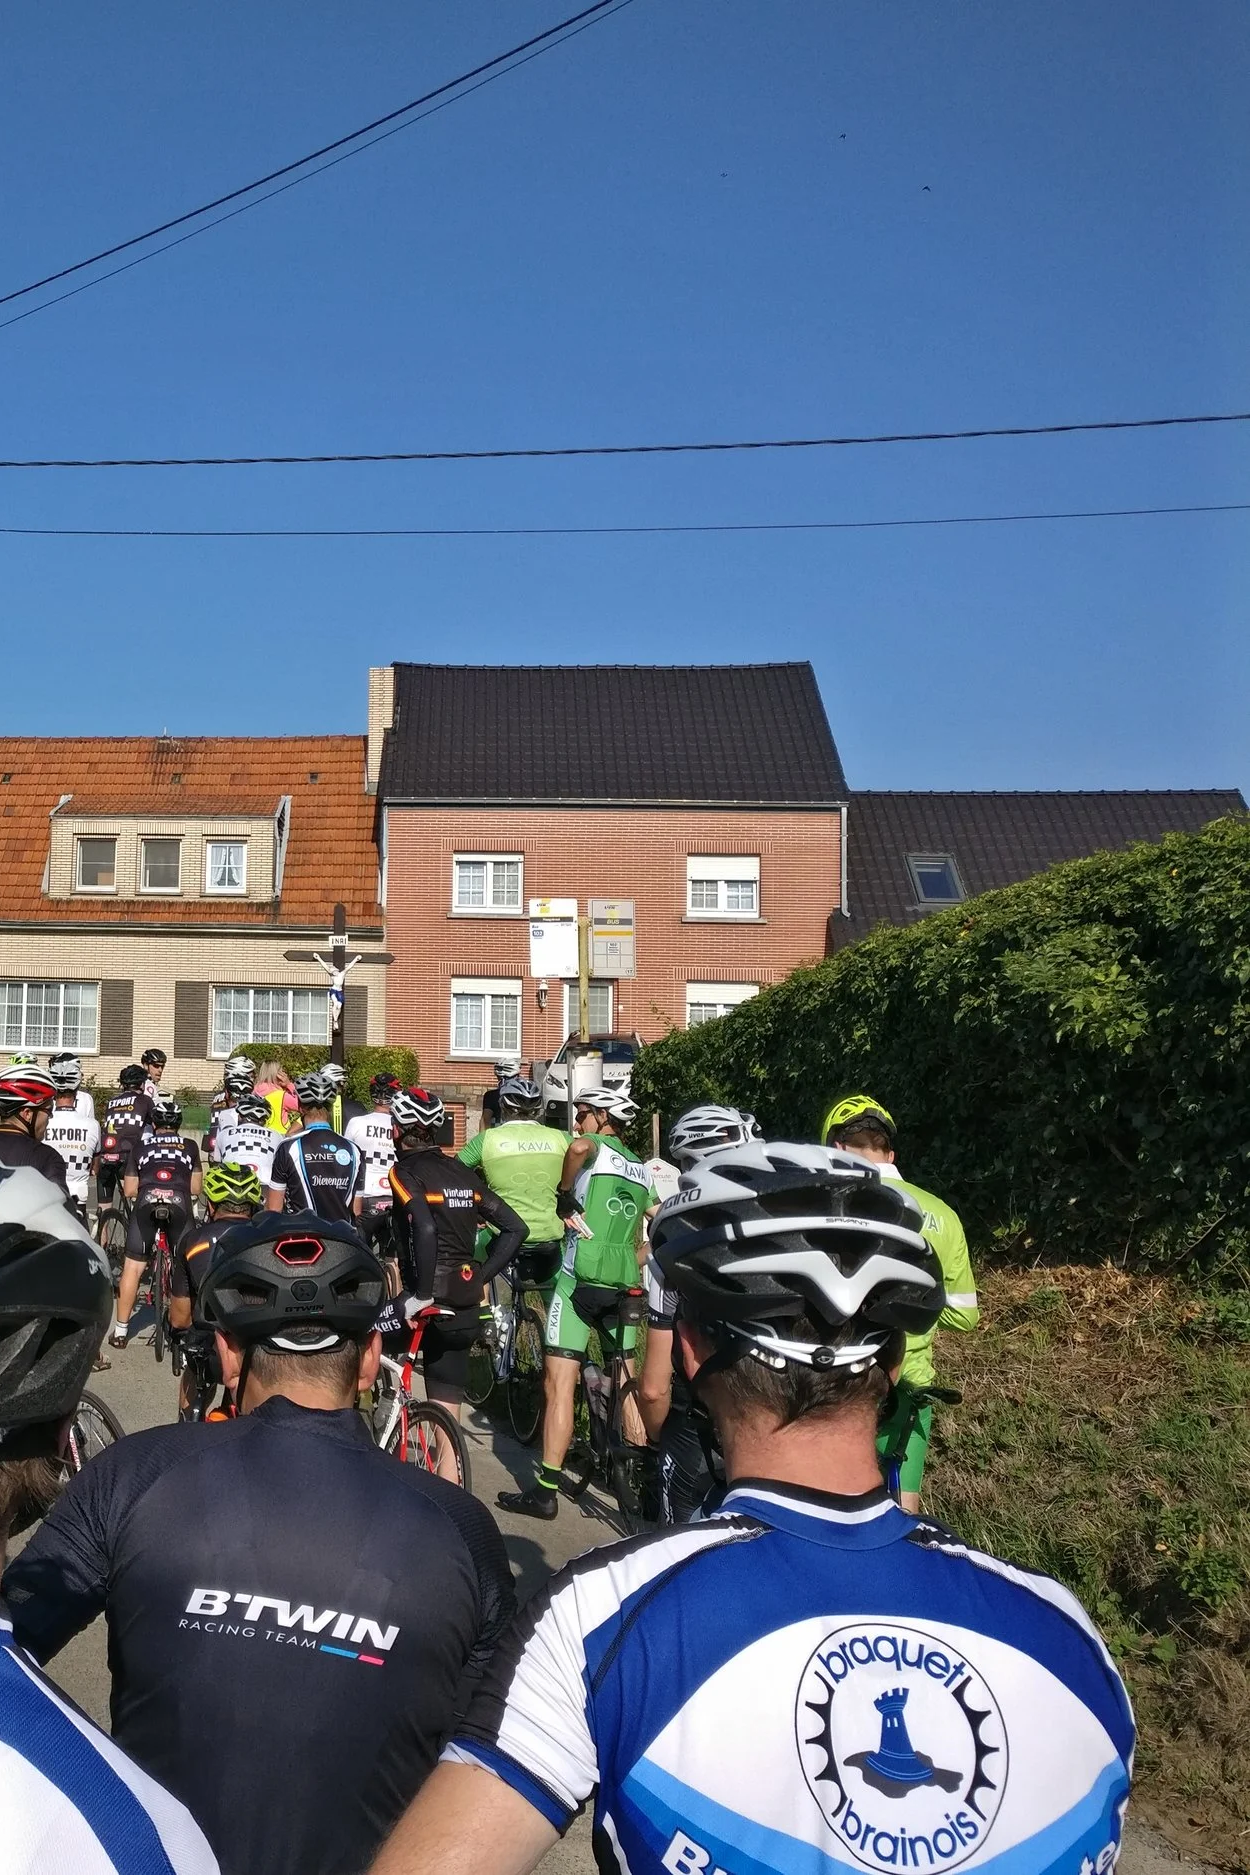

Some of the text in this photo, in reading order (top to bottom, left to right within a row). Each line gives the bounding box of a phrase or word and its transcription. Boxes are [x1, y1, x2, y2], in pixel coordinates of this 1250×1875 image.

[331, 937, 347, 945] INRI
[108, 1096, 137, 1107] EXPORT
[45, 1128, 88, 1142] EXPORT
[228, 1127, 272, 1138] EXPORT
[366, 1125, 393, 1139] EXPO
[144, 1136, 184, 1146] EXPORT
[518, 1142, 552, 1152] KAVA
[624, 1164, 647, 1182] KAVA
[443, 1188, 474, 1198] Vintage
[664, 1188, 702, 1210] GIRO
[449, 1199, 473, 1208] Bikers
[825, 1218, 870, 1227] SAVANT
[550, 1302, 561, 1328] KAVA
[178, 1618, 317, 1650] RACING TEAM
[817, 1633, 966, 1688] braquet
[840, 1799, 980, 1868] brainois
